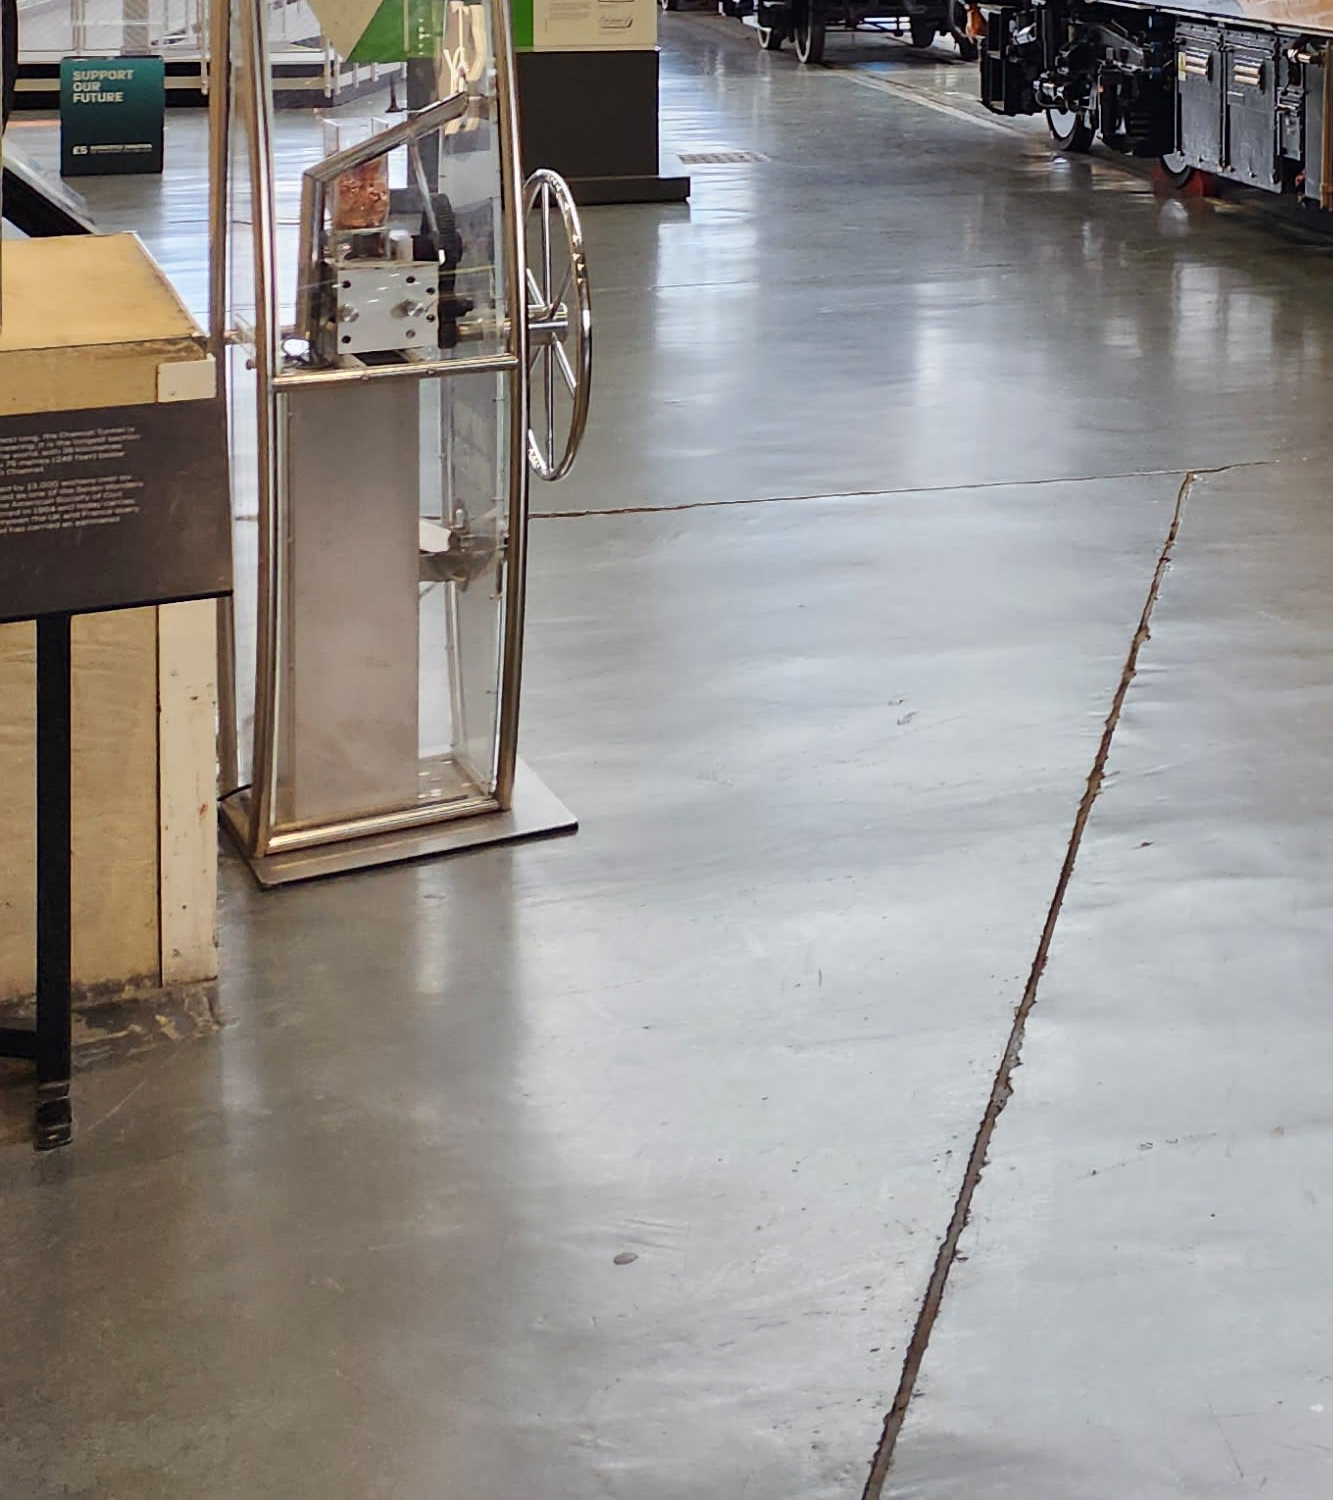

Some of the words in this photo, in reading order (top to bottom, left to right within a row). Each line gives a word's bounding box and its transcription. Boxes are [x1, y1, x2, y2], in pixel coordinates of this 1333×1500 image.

[72, 69, 134, 80] SUPPORT
[72, 81, 101, 92] OUR
[72, 92, 124, 103] FUTURE
